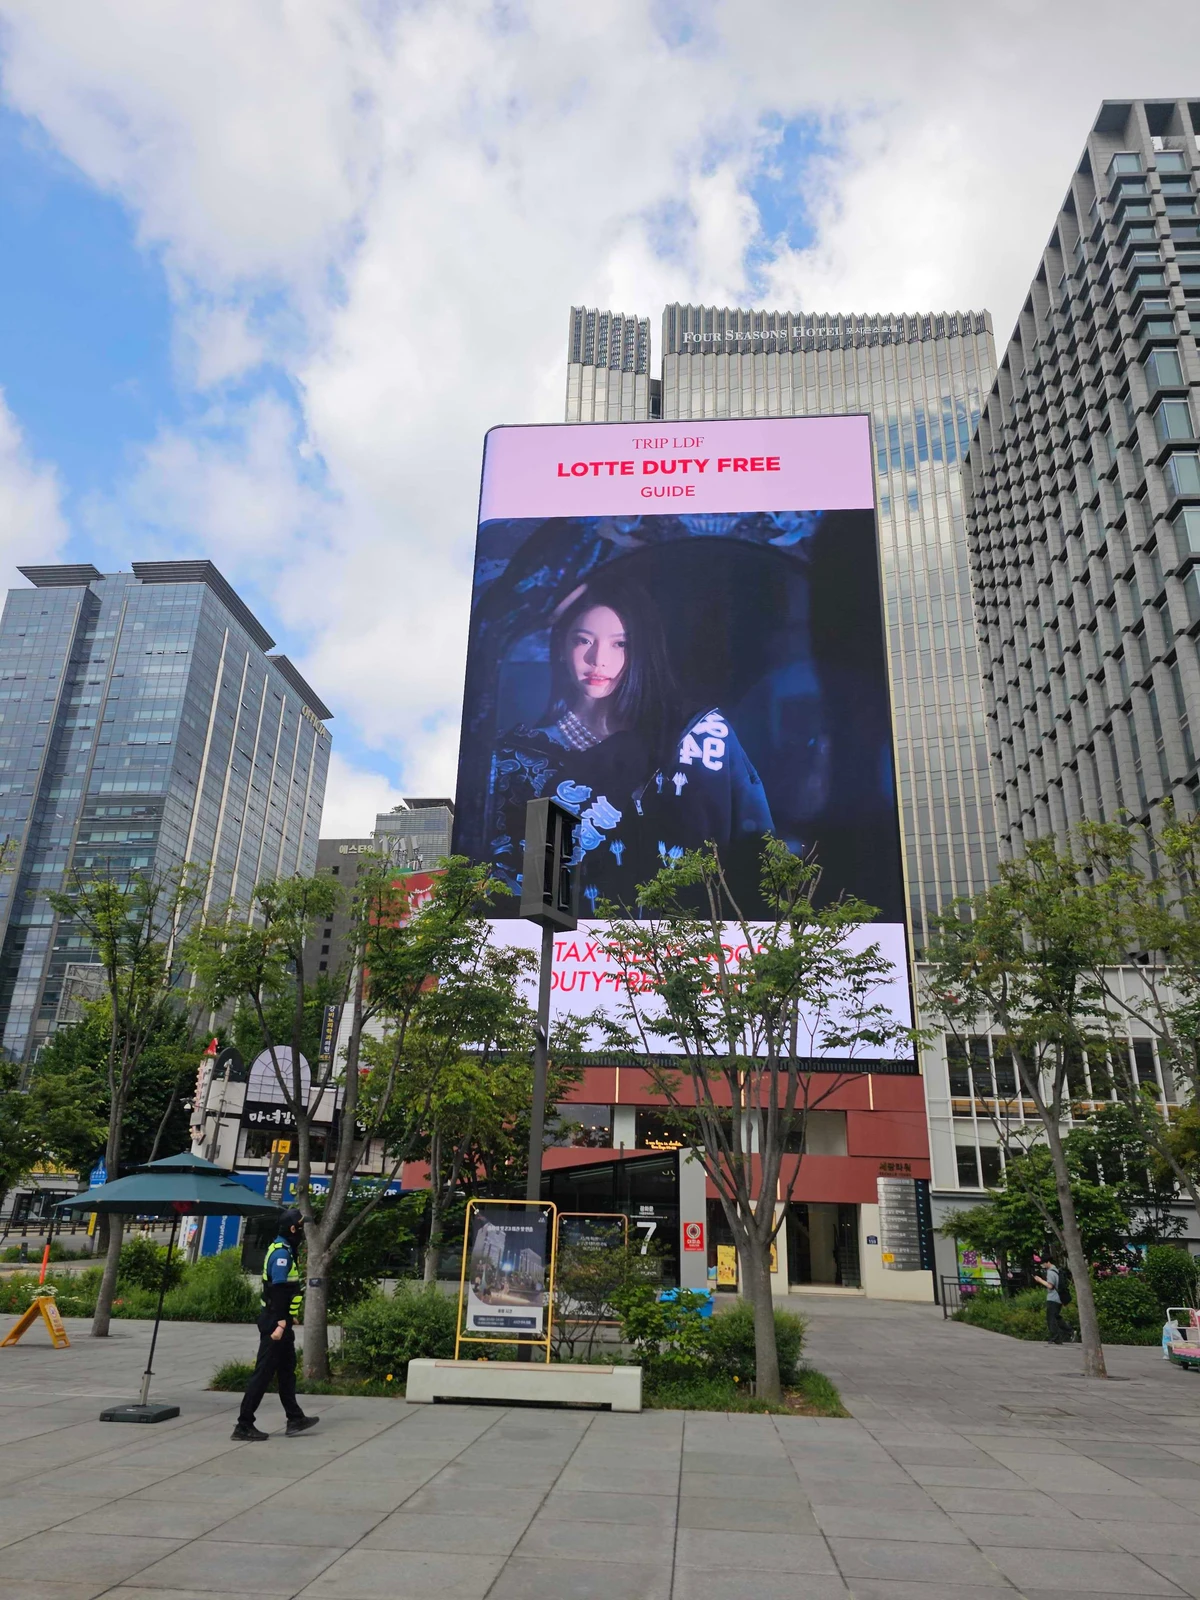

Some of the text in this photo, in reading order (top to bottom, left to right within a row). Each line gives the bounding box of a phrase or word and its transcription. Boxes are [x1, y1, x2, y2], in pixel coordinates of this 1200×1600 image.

[683, 326, 843, 344] FOUR SEASONS HOTEL
[632, 436, 705, 449] TRIP LDF
[557, 456, 781, 477] LOTTE DUTY FREE
[641, 485, 696, 498] GUIDE
[636, 1221, 657, 1255] 7
